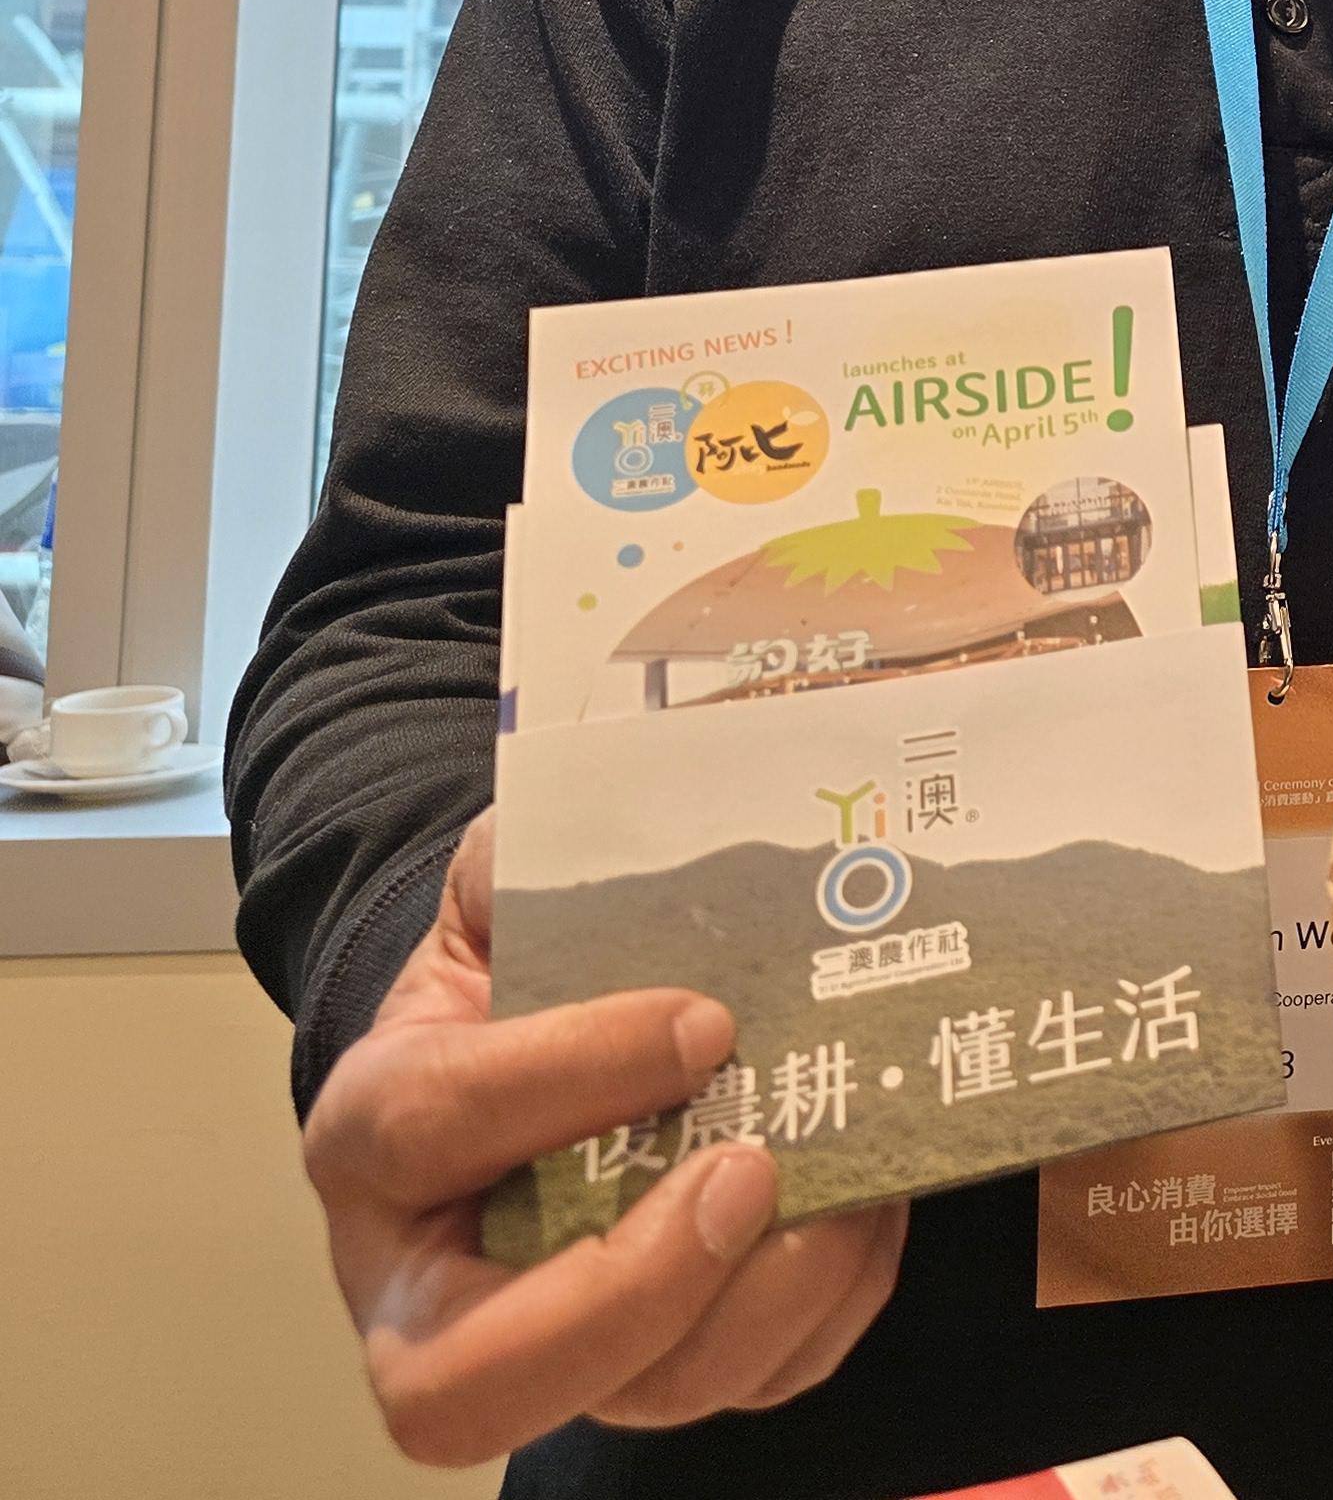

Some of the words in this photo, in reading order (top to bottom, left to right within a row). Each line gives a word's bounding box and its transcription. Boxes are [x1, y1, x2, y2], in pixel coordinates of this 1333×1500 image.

[576, 341, 695, 380] EXCITING
[843, 354, 938, 379] launches
[945, 351, 967, 368] at
[952, 426, 977, 441] on
[981, 416, 1057, 450] April
[1063, 408, 1099, 437] 5th
[1263, 779, 1325, 792] Ceremony
[1087, 1173, 1216, 1217] 良心消費
[1169, 1202, 1298, 1246] 由你選擇
